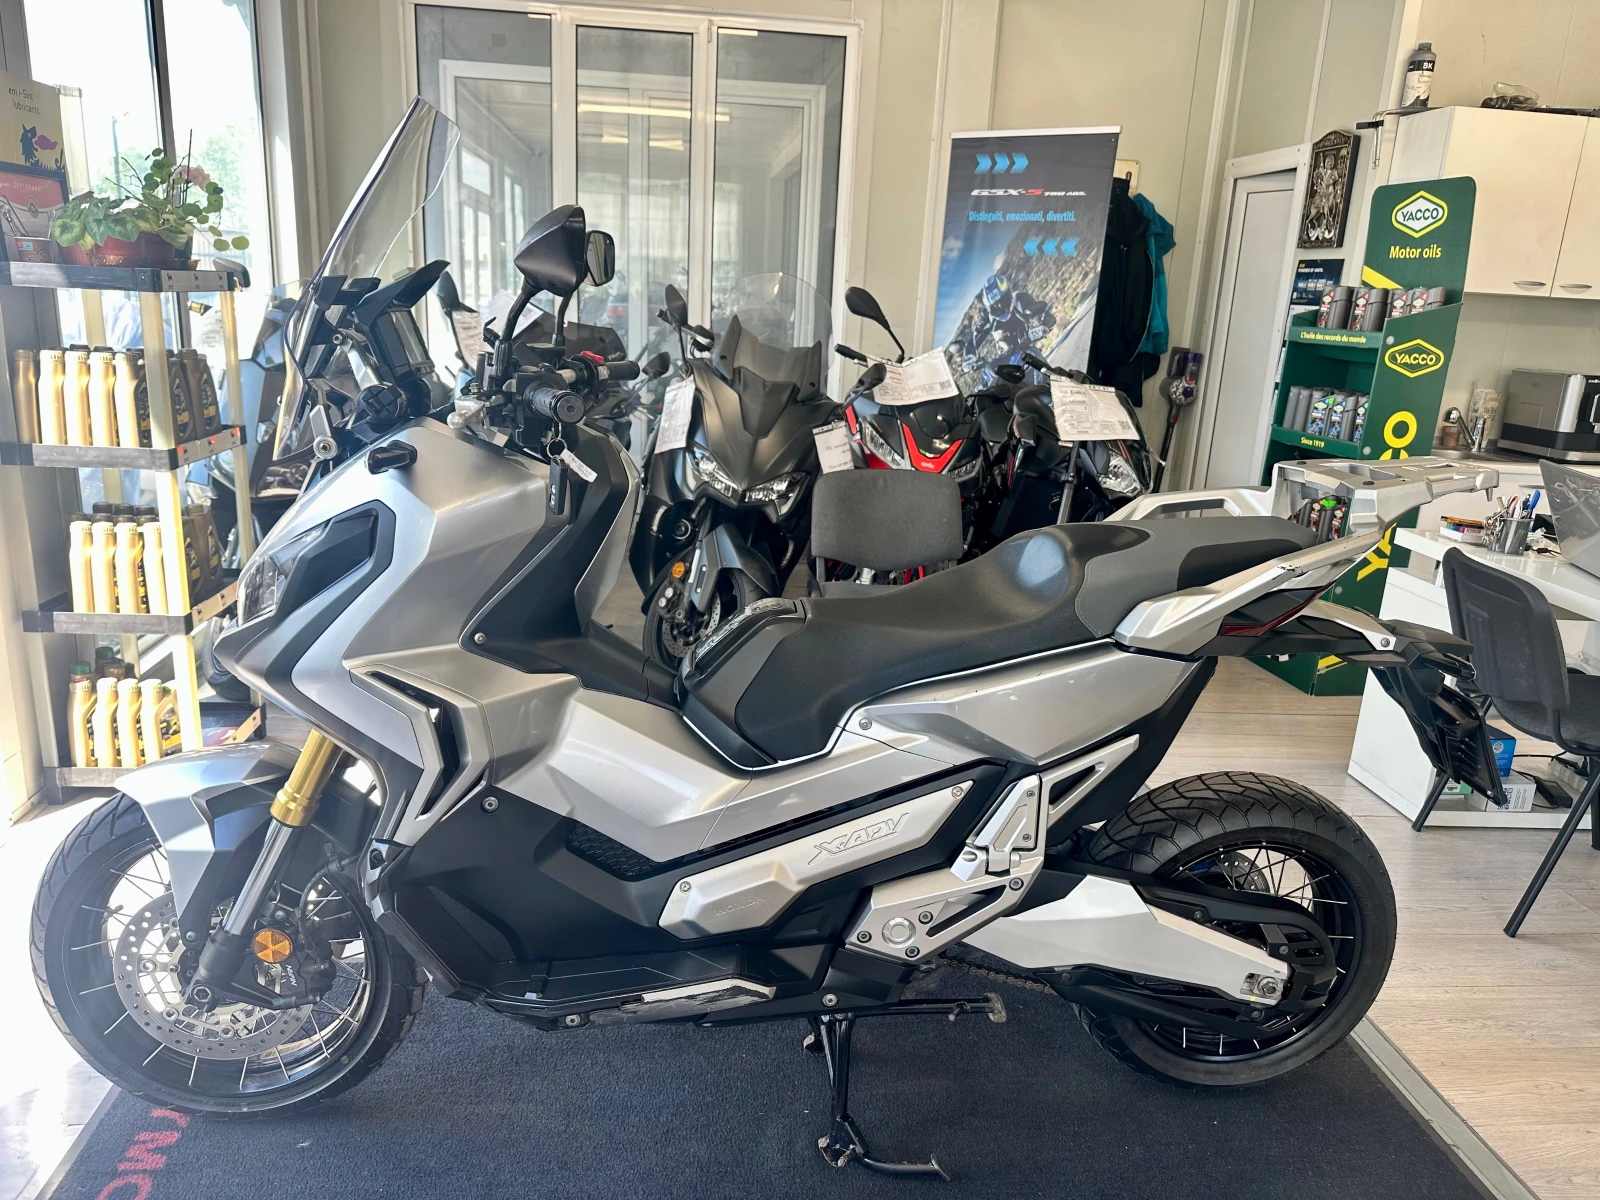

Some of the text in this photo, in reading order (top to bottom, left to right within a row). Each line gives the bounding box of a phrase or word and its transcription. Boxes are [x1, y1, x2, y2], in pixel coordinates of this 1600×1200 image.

[12, 98, 40, 115] lubricants
[968, 211, 1076, 223] Distinguiti, emozionati, divertiti.
[1401, 207, 1439, 222] YACCO
[1389, 244, 1442, 259] Motor oils
[1300, 331, 1367, 344] L'huile des records du monde
[1395, 353, 1436, 366] YACCO
[1300, 436, 1325, 448] Since 1919
